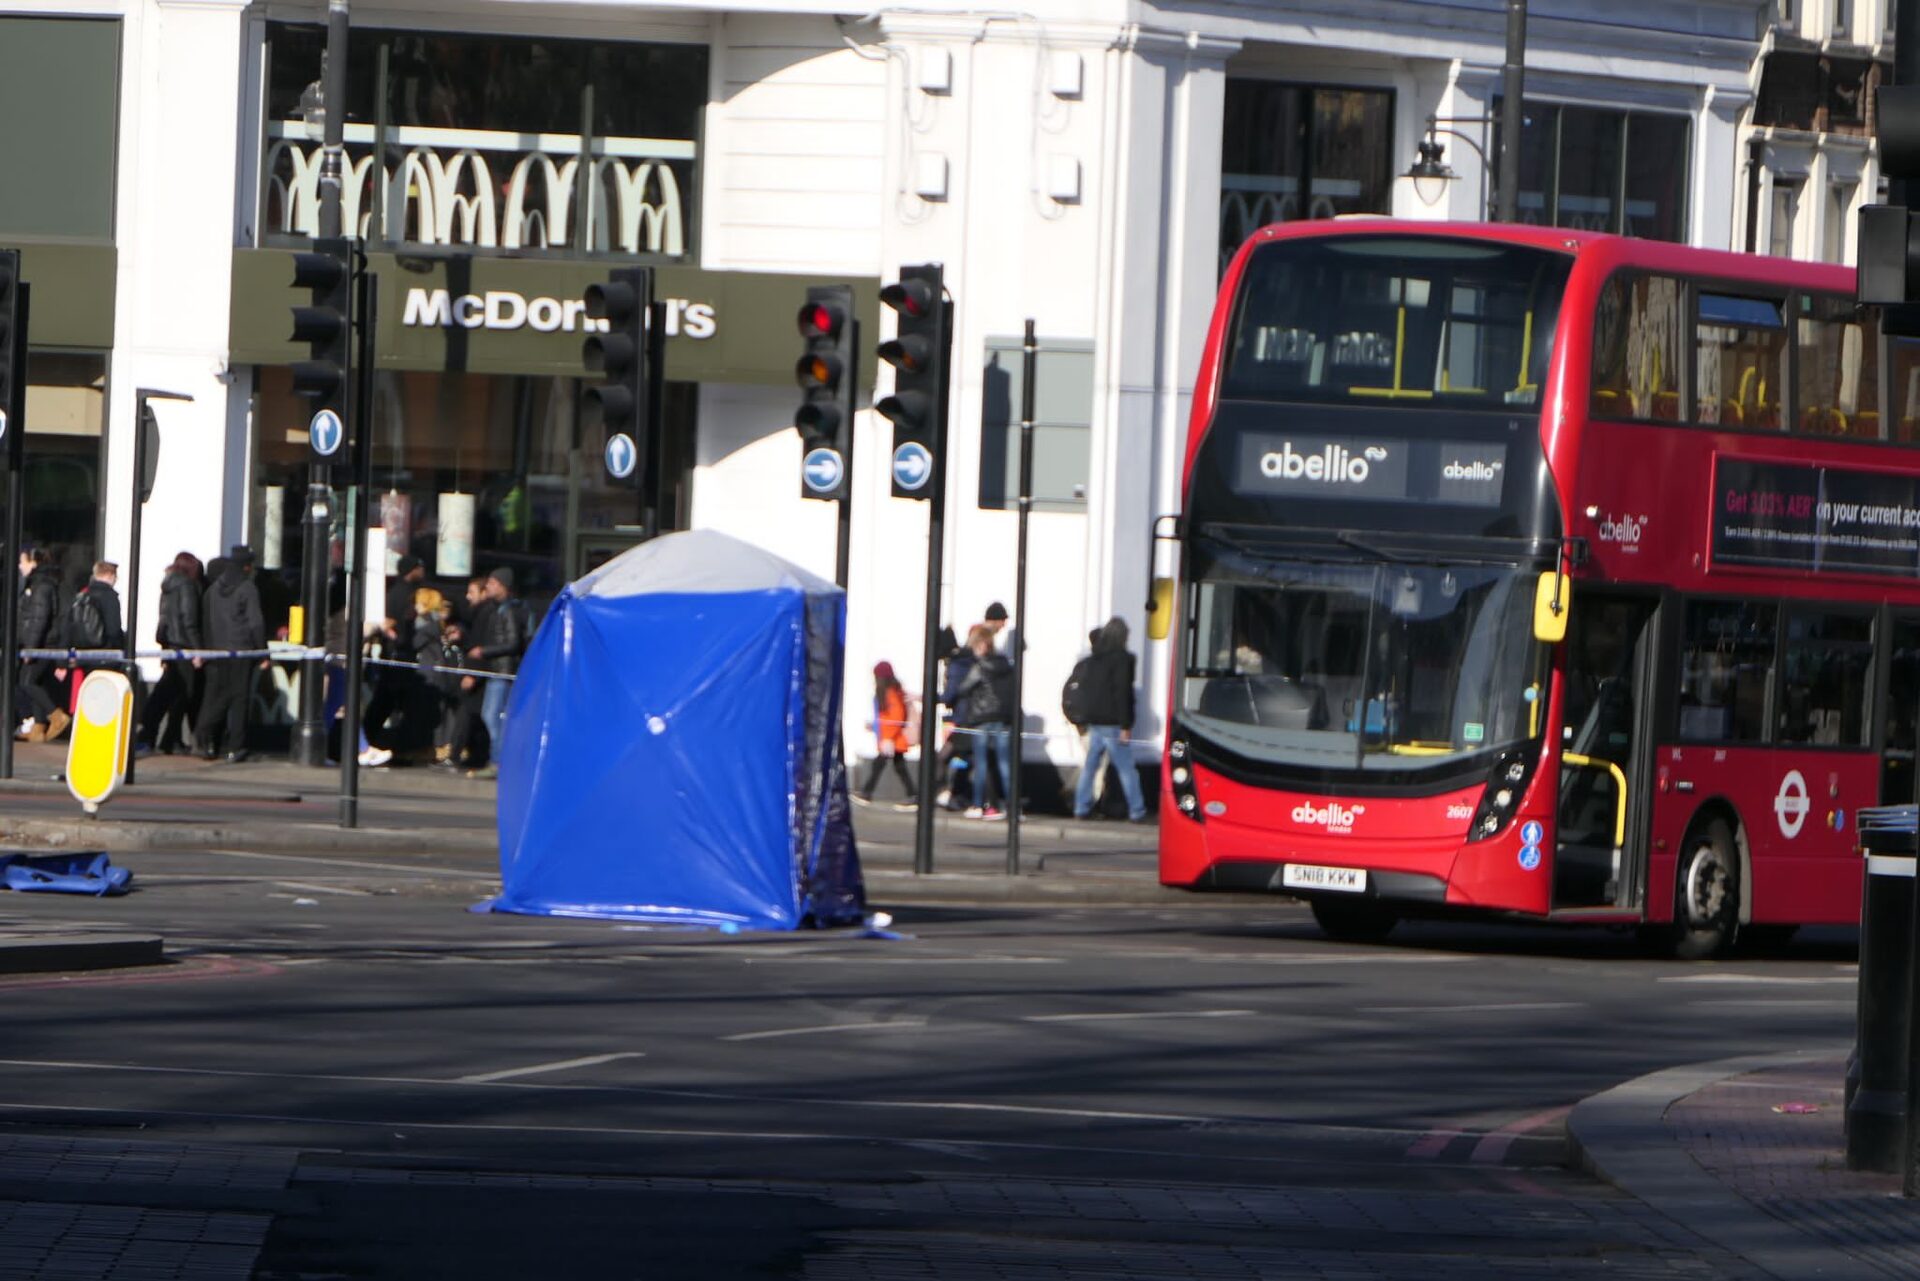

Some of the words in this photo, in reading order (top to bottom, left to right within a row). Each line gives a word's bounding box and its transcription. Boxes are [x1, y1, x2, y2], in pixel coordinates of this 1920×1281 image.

[1260, 442, 1369, 483] abellio
[1443, 460, 1495, 481] abellio
[1726, 489, 1747, 513] Get
[1816, 502, 1831, 520] on
[1832, 502, 1859, 526] your
[1861, 504, 1901, 526] current
[1599, 512, 1641, 543] abellio
[1291, 800, 1355, 827] abellio
[1447, 805, 1473, 819] 2607
[1328, 870, 1356, 886] KKW
